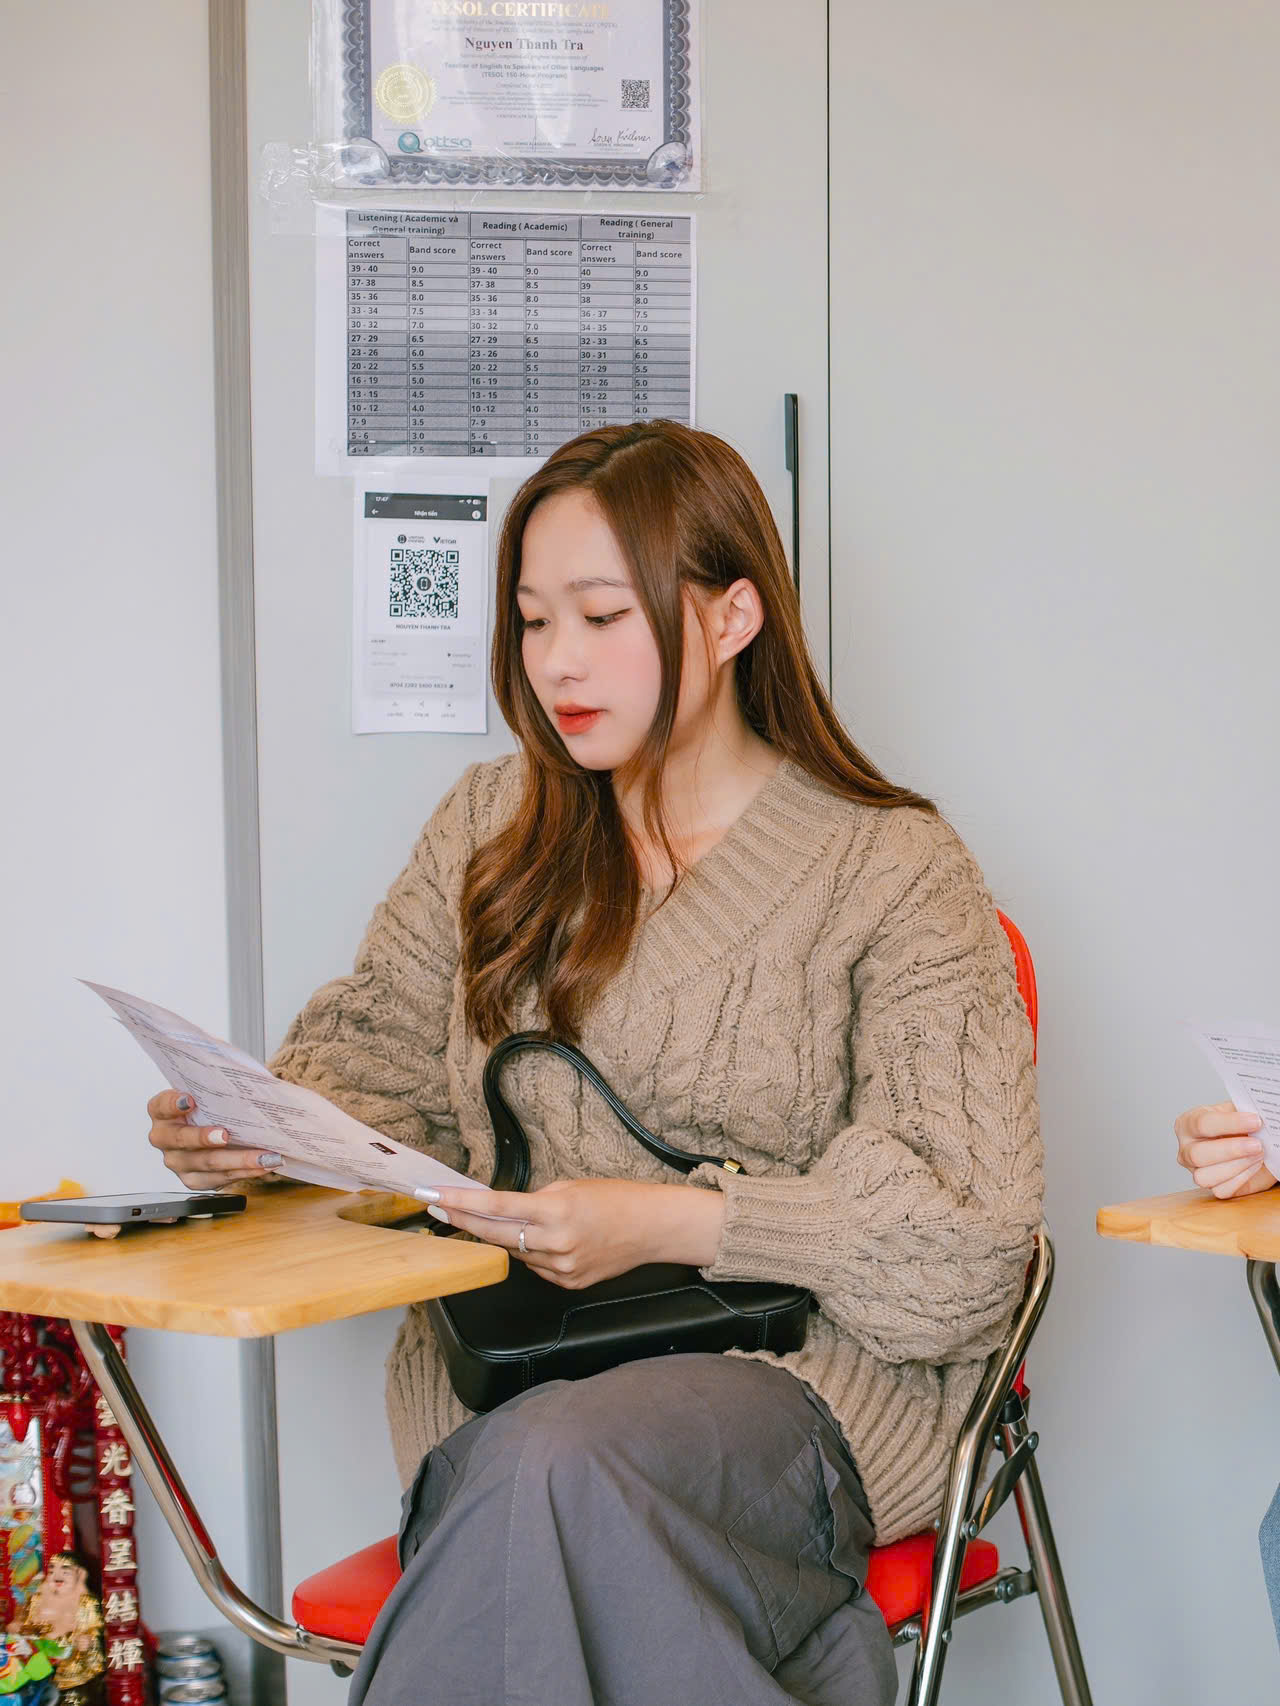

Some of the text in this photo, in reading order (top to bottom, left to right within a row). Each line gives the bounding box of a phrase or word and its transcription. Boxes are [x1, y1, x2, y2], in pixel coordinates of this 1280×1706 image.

[464, 37, 584, 52] Nguyen Thanh Tra
[570, 64, 605, 73] Languages
[358, 213, 459, 224] Listening Academic và
[482, 221, 568, 232] Reading Academic)
[600, 218, 673, 229] Reading General
[372, 225, 446, 236] General training)
[618, 231, 655, 240] training)
[348, 239, 381, 247] Correct
[470, 241, 502, 249] Correct
[409, 246, 431, 254] Band
[581, 243, 612, 252] Correct
[348, 251, 385, 259] answers
[526, 248, 548, 256] Band
[636, 250, 658, 258] Band
[470, 253, 506, 261] answers
[351, 264, 379, 273] 39 40
[411, 265, 424, 274] 9.0
[470, 266, 498, 275] 39 40
[526, 267, 539, 275] 9.0
[635, 269, 649, 277] 9.0
[351, 279, 376, 287] 37- 38
[411, 279, 424, 287] 8.5
[470, 281, 496, 289] 37- 38
[526, 281, 539, 289] 8.5
[581, 282, 591, 290] 39
[635, 283, 649, 291] 8.5
[351, 293, 379, 301] 35 36
[411, 293, 424, 301] 8.0
[470, 294, 498, 302] 35 36
[526, 295, 539, 303] 8.0
[581, 296, 591, 304] 38
[635, 297, 649, 305] 8.0
[351, 306, 379, 314] 33 34
[411, 307, 424, 315] 7.5
[470, 308, 498, 316] 33 34
[526, 309, 539, 317] 7.5
[581, 310, 607, 318] 36 37
[635, 311, 649, 319] 7.5
[351, 321, 379, 329] 30 32
[411, 321, 424, 329] 7.0
[470, 322, 498, 330] 30 32
[526, 323, 539, 331] 7.0
[581, 324, 607, 332] 34 35
[635, 324, 649, 332] 7.0
[351, 334, 379, 343] 27 29
[411, 335, 424, 343] 6.5
[470, 336, 498, 344] 27 29
[526, 336, 539, 345] 6.5
[581, 337, 607, 346] 32 33
[634, 338, 648, 346] 6.5
[351, 348, 379, 357] 23 26
[411, 349, 424, 357] 6.0
[470, 350, 498, 358] 23 26
[526, 350, 539, 358] 6.0
[581, 351, 607, 359] 30 31
[634, 352, 648, 360] 6.0
[351, 362, 379, 370] 20 22
[411, 363, 424, 371] 5.5
[526, 364, 539, 372] 5.5
[581, 365, 607, 373] 27 29
[634, 365, 648, 373] 5.5
[351, 376, 379, 384] 16 19
[411, 377, 424, 385] 5.0
[526, 378, 539, 386] 5.0
[581, 379, 609, 387] 23 26
[634, 379, 648, 387] 5.0
[351, 390, 379, 398] 13 15
[411, 390, 424, 399] 4.5
[470, 391, 498, 399] 13 15
[581, 392, 607, 400] 19 22
[351, 404, 379, 412] 10 12
[411, 404, 424, 412] 4.0
[471, 405, 481, 413] 10
[526, 405, 539, 413] 4.0
[581, 406, 607, 414] 15 18
[411, 418, 424, 426] 3.5
[526, 419, 539, 427] 3.5
[411, 432, 424, 440] 3.0
[526, 433, 539, 441] 3.0
